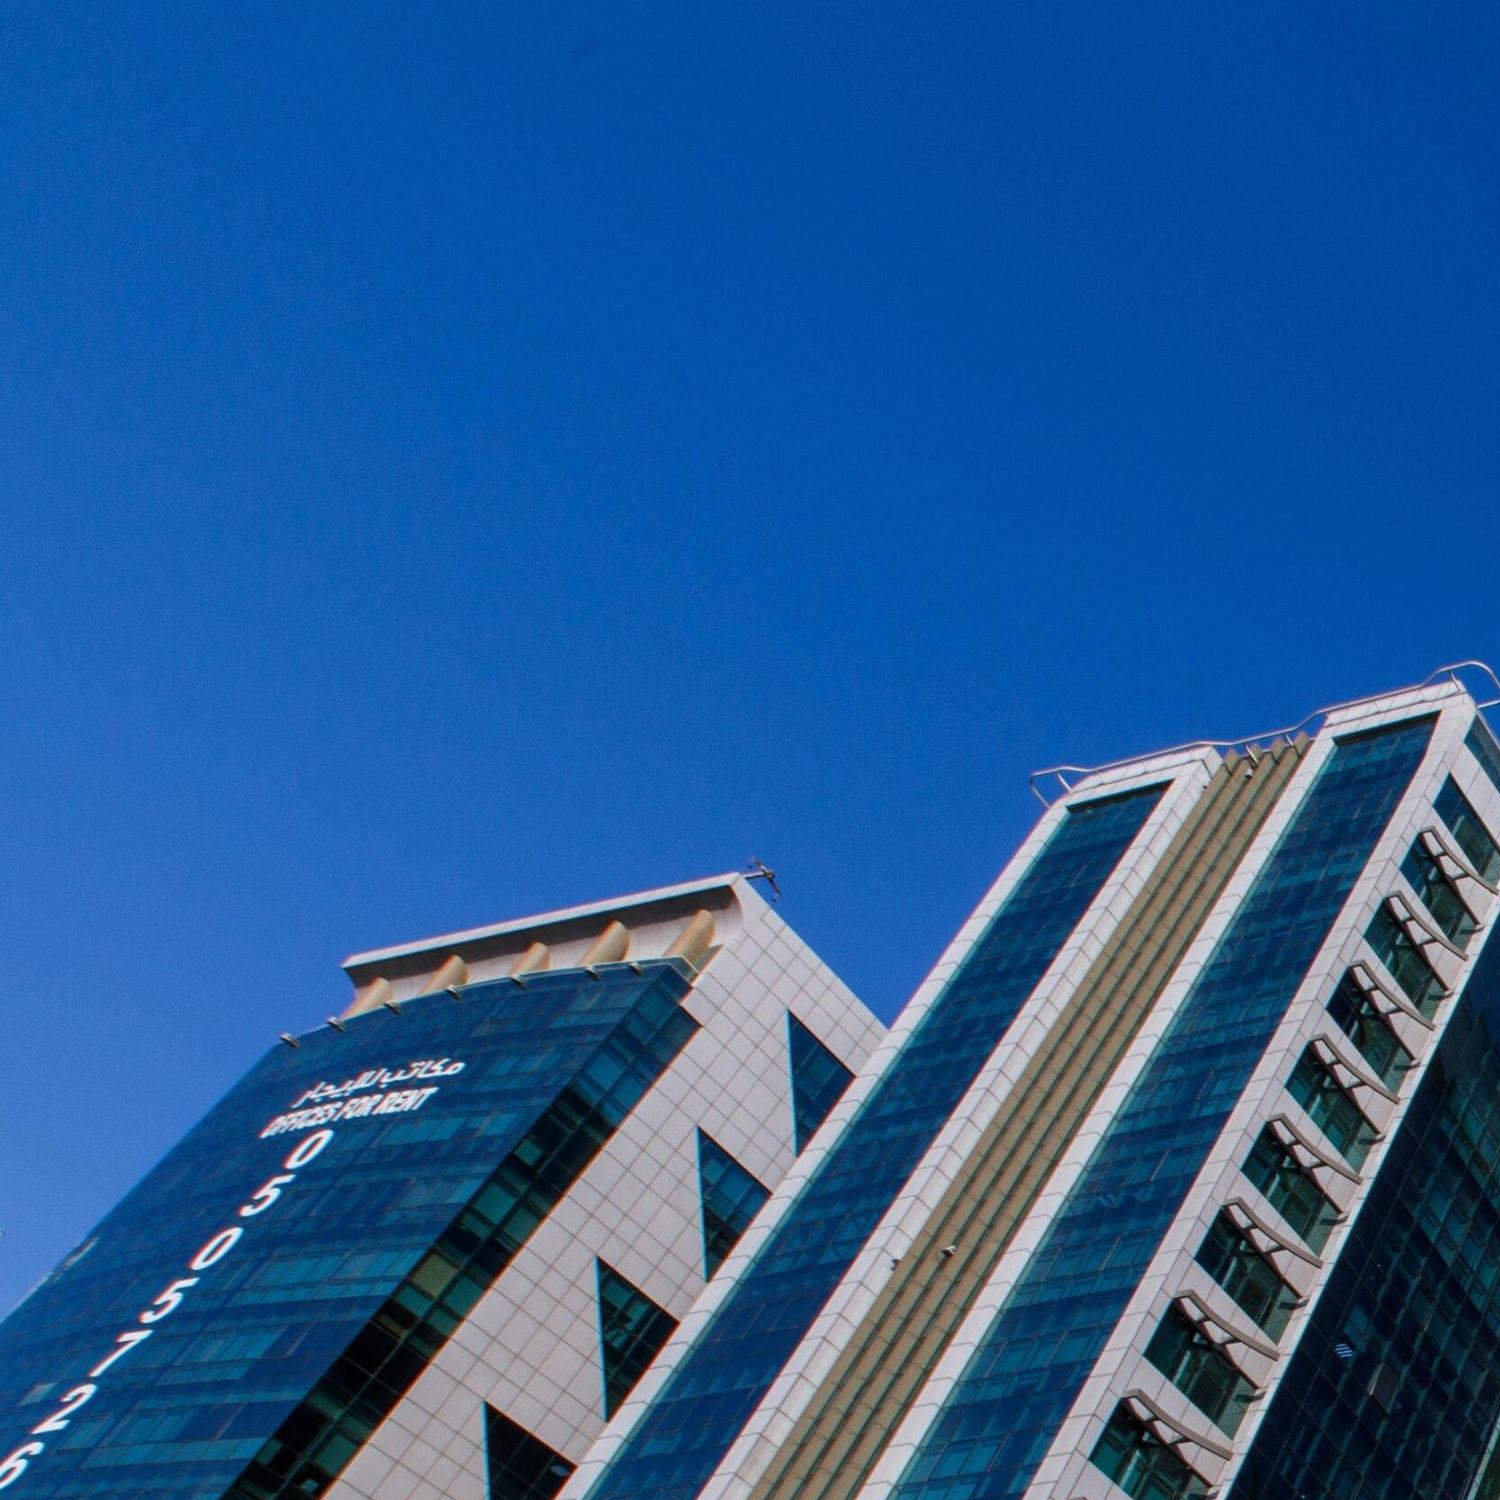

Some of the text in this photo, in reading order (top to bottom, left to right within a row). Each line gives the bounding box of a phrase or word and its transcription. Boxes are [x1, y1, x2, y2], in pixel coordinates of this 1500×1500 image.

[259, 1087, 440, 1139] OFFICES FOR RENT
